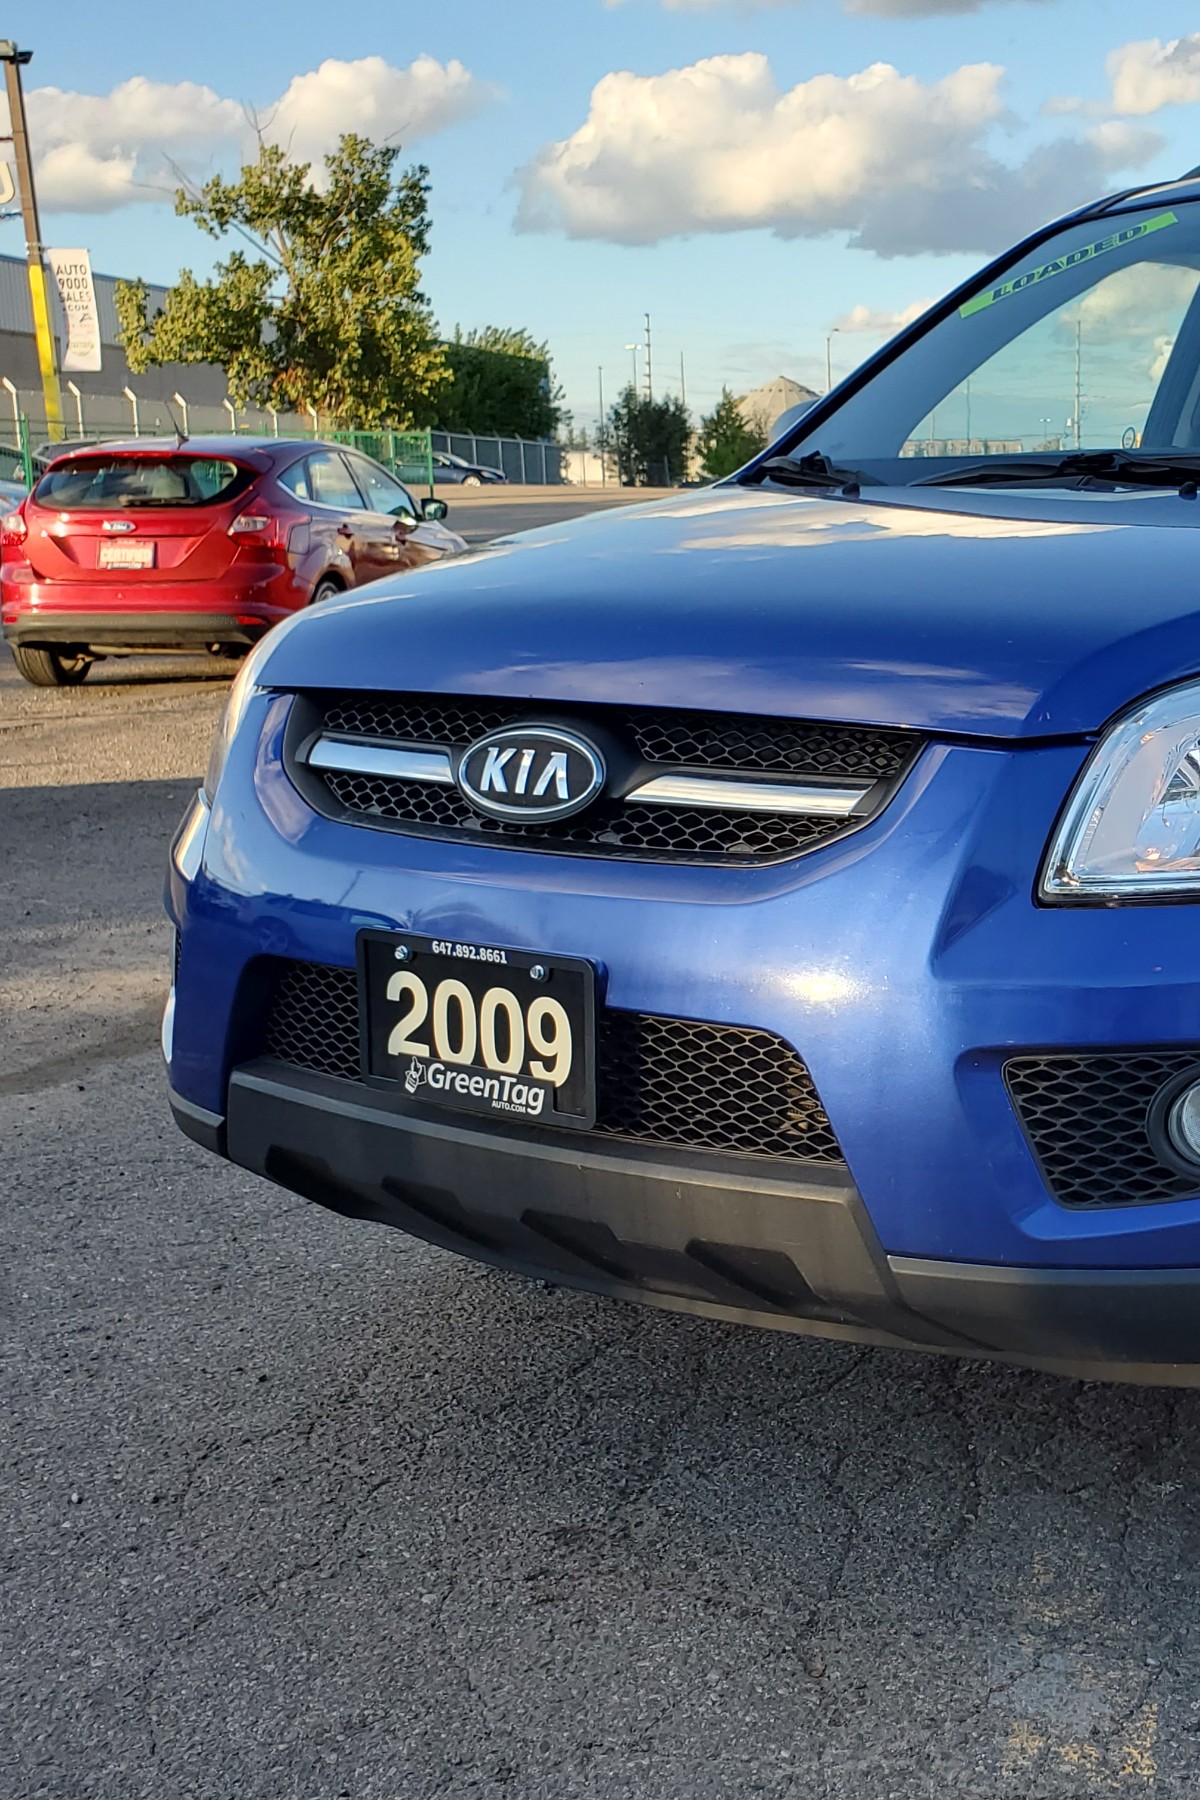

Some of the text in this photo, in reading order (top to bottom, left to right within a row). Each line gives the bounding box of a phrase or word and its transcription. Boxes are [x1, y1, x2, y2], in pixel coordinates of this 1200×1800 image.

[56, 264, 88, 276] AUTO
[992, 224, 1148, 301] LOADED
[58, 277, 88, 290] 9000
[58, 291, 92, 304] SALES
[480, 747, 569, 800] KIA
[431, 940, 508, 965] 647.892.8661
[386, 970, 573, 1088] 2009
[427, 1062, 546, 1116] GreenTag
[491, 1100, 527, 1114] AUTO.COM
